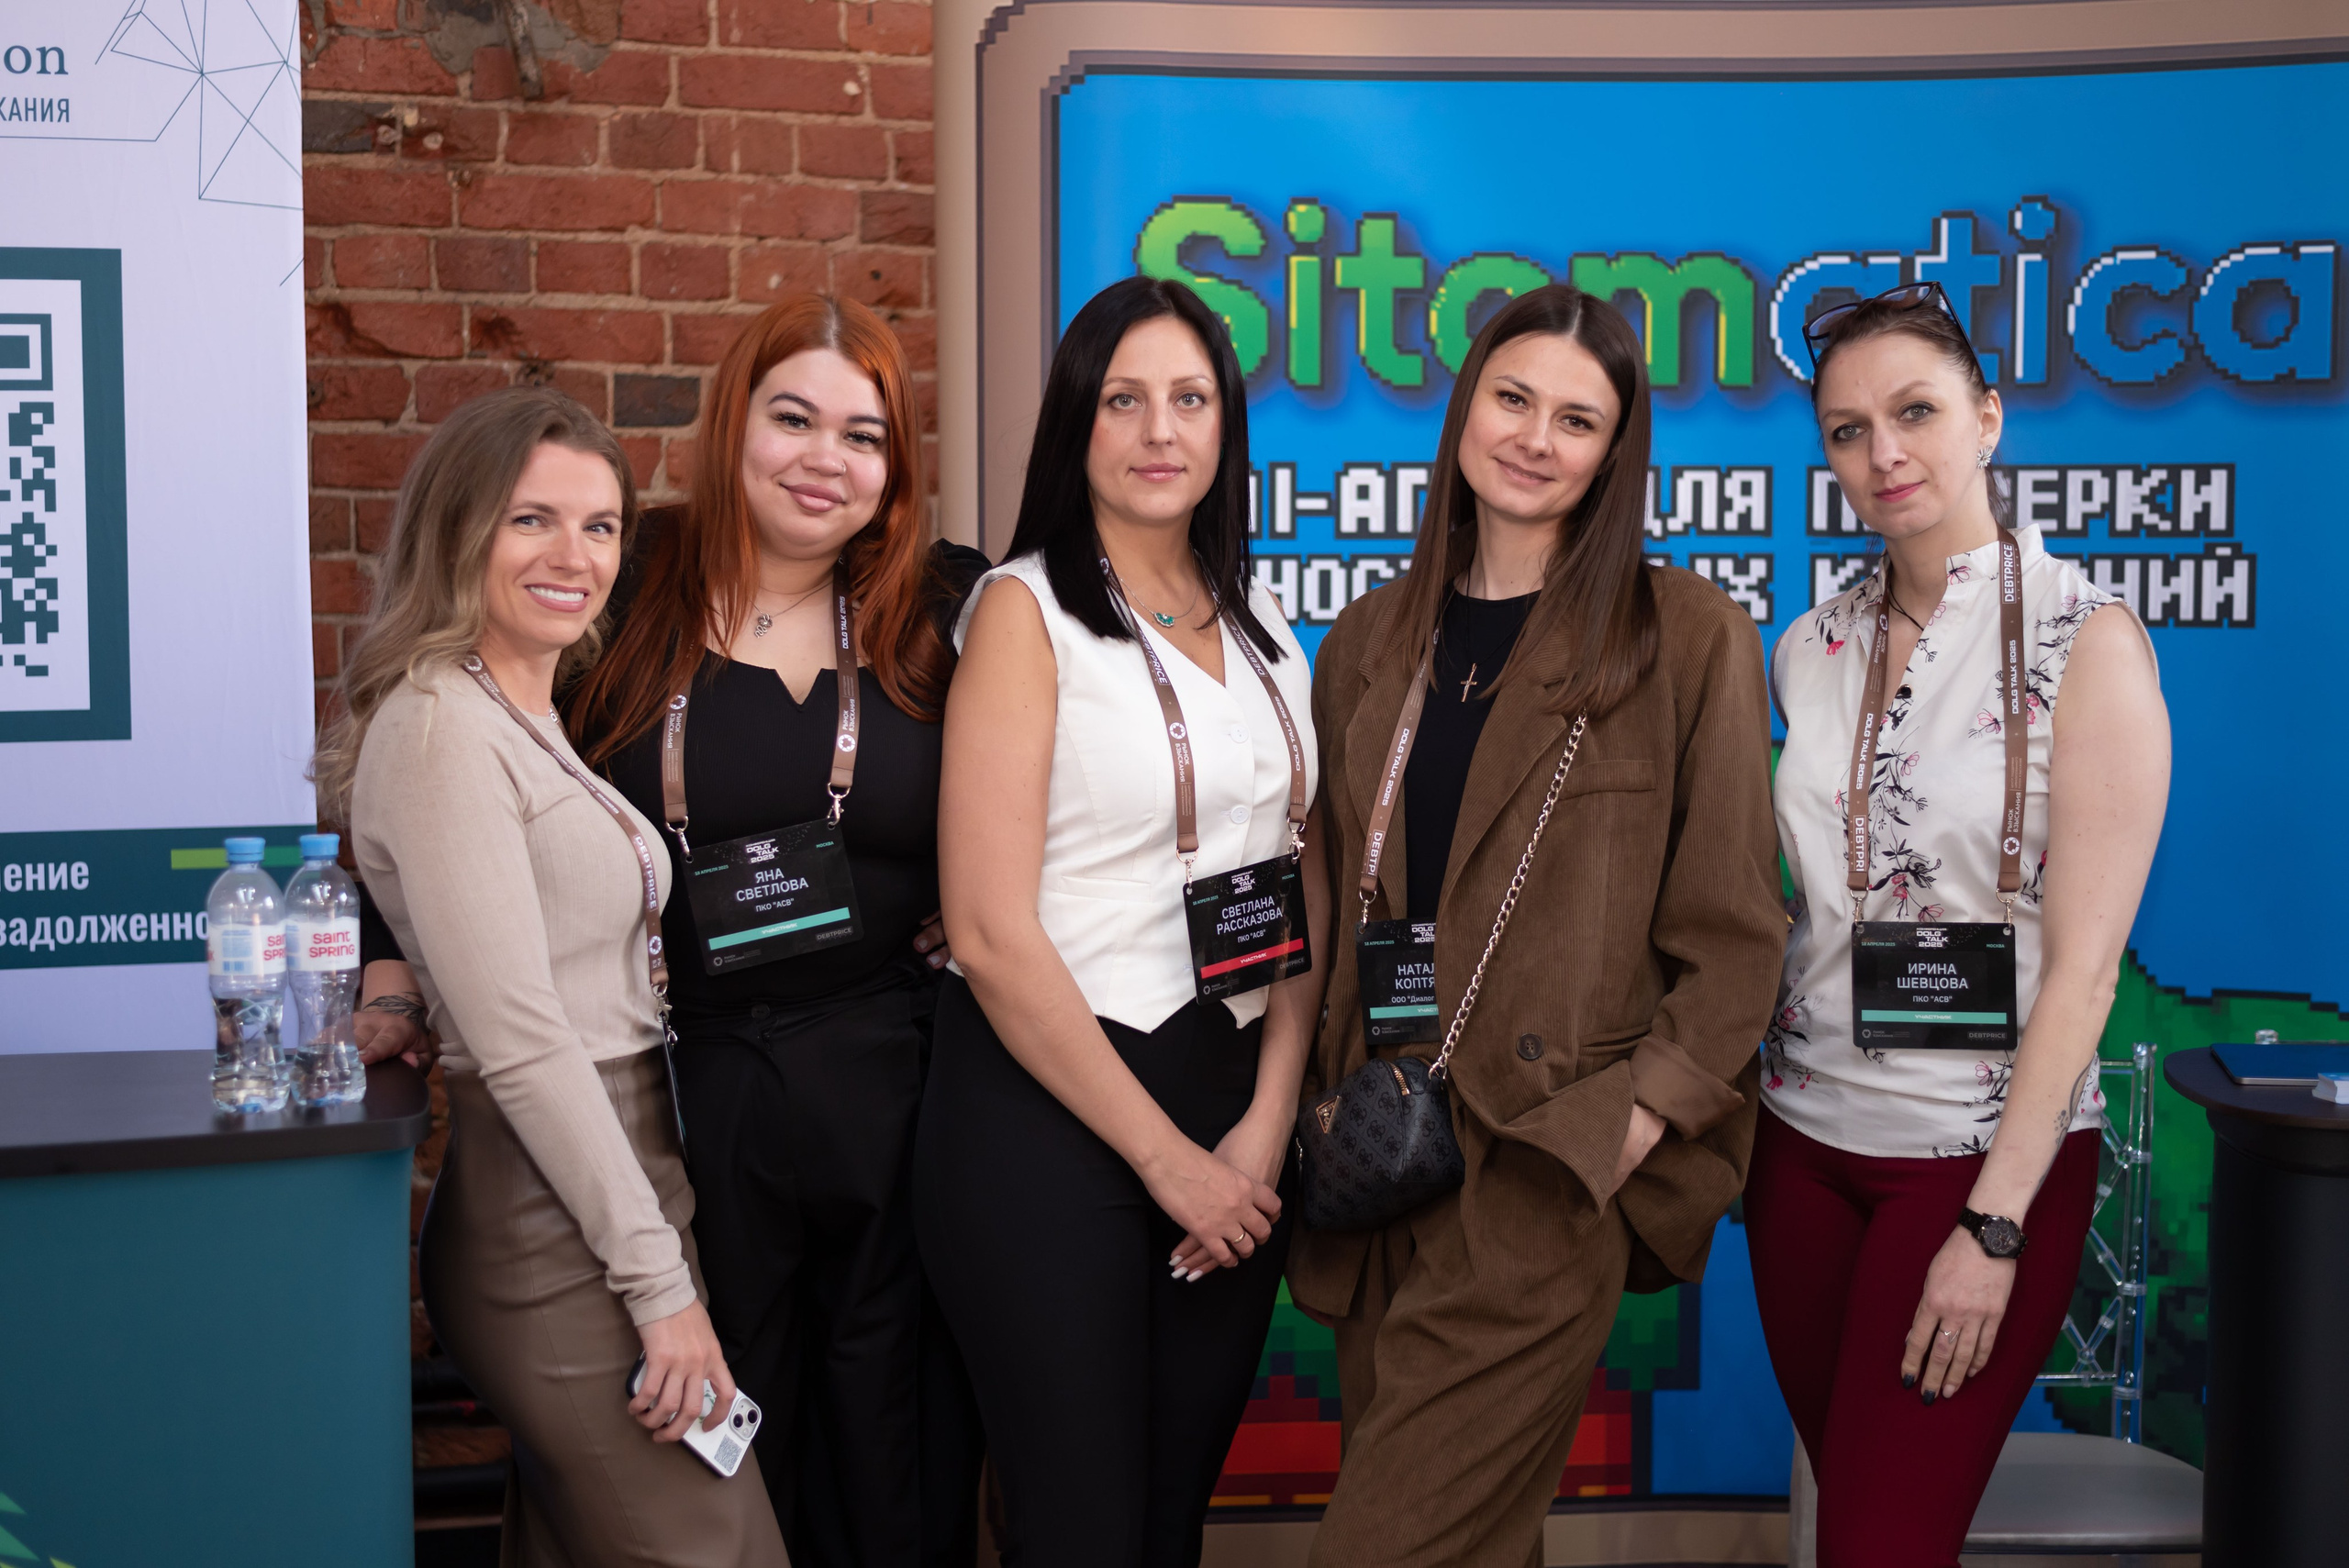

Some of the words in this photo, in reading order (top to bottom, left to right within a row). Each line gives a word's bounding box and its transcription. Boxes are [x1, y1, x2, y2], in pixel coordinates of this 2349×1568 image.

[2003, 543, 2015, 603] DEBTPRICE
[1230, 623, 1264, 676] DEBTPRICE
[1285, 720, 1295, 743] TALK
[1864, 713, 1874, 738] DOLG
[1397, 728, 1410, 753] DOLG
[1860, 739, 1869, 762] TALK
[1175, 742, 1186, 783] ВЗЫСКАНИЯ
[1181, 742, 1190, 765] РЫНОК
[1389, 754, 1402, 779] TALK
[1855, 763, 1865, 790] 2025
[1381, 779, 1394, 806] 2025
[2013, 791, 2021, 833] ВЗЫСКАНИЯ
[746, 843, 771, 853] DOLG
[751, 854, 774, 863] 2025
[756, 846, 779, 856] TALK
[0, 860, 89, 893] ение
[635, 836, 658, 909] DEBTPRICE
[755, 868, 785, 884] ЯНА
[1231, 875, 1250, 884] DOLG
[1239, 878, 1255, 887] TALK
[736, 877, 808, 902] СВЕТЛОВА
[1235, 885, 1252, 895] 2025
[756, 902, 772, 912] ПКО
[1221, 895, 1275, 919] СВЕТЛАНА
[1217, 906, 1283, 935] РАССКАЗОВА
[817, 928, 852, 940] DEBTPRICE
[1237, 934, 1250, 943] ПКО
[1908, 962, 1957, 974] ИРИНА
[1897, 977, 1968, 990] ШЕВЦОВА
